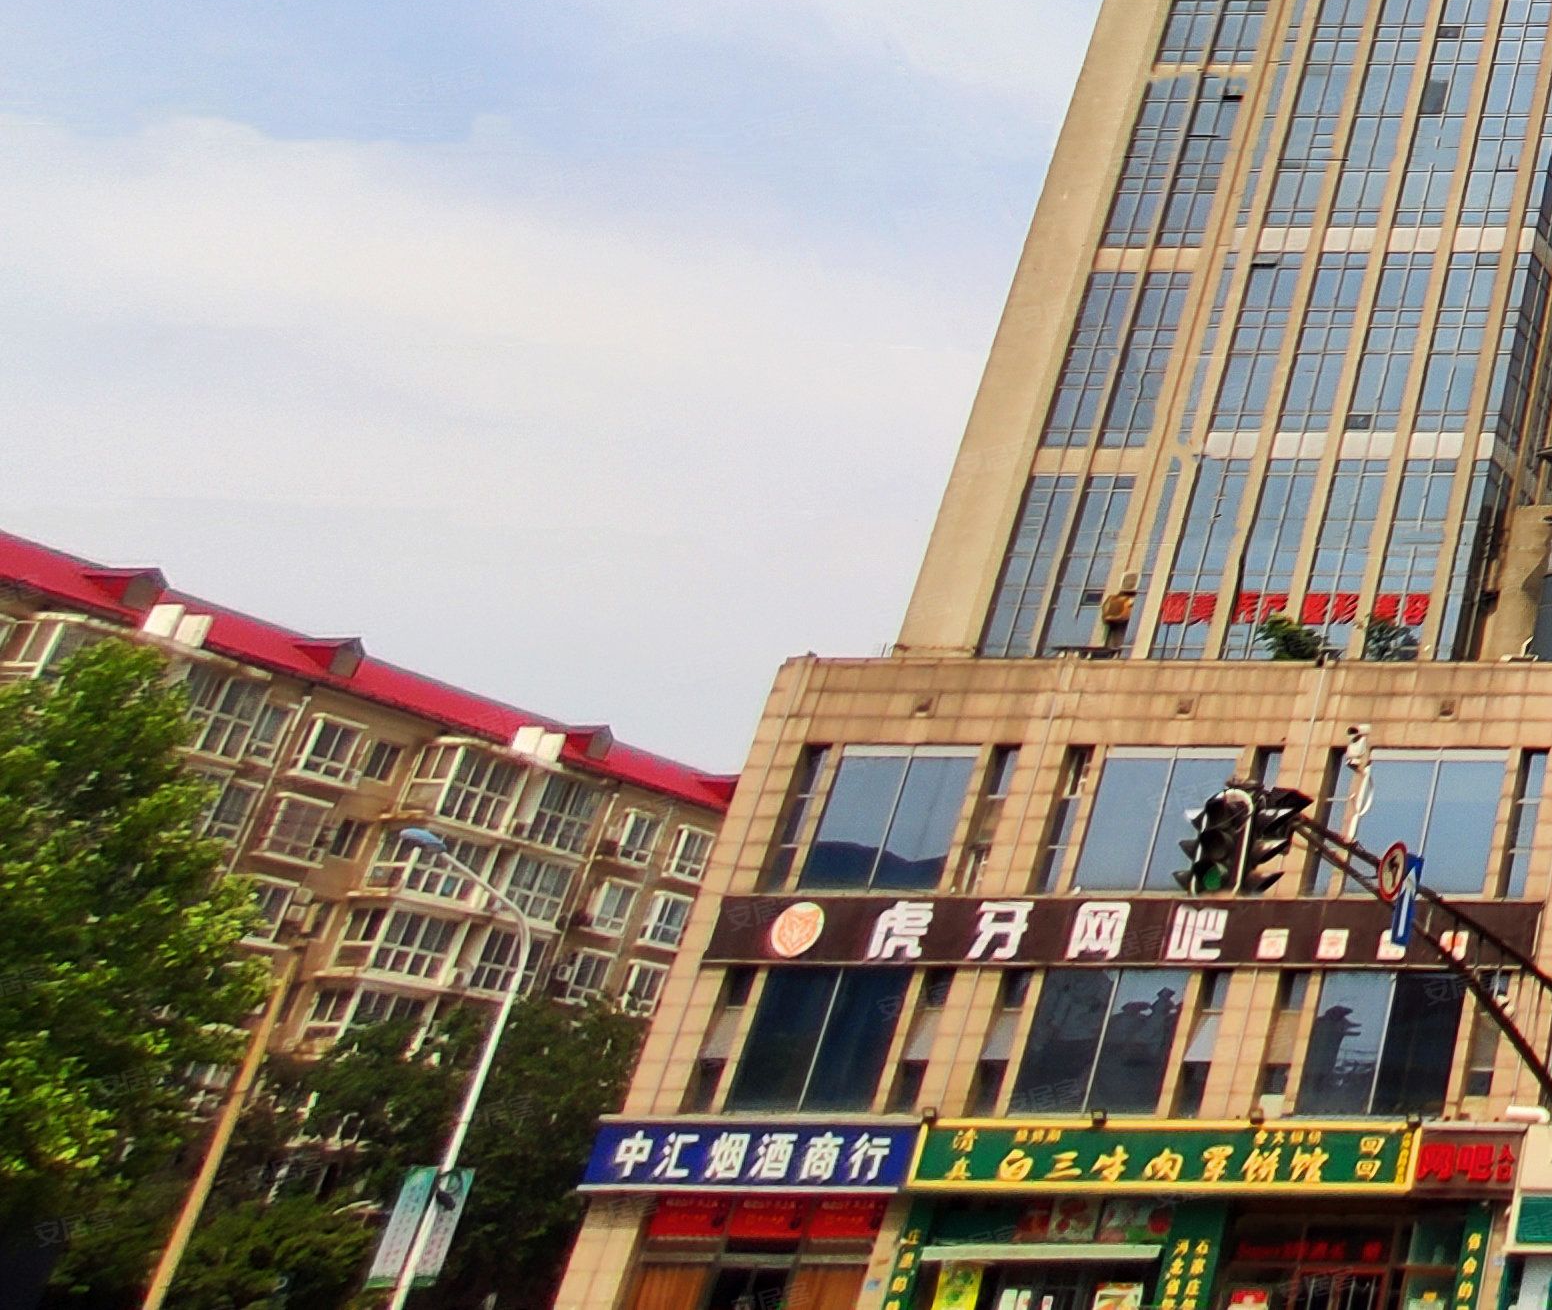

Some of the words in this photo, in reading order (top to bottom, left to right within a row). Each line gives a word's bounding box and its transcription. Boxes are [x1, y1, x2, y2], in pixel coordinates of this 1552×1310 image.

[866, 901, 1228, 961] 虎牙网吧
[613, 1129, 892, 1180] 中汇烟酒商行
[1416, 1143, 1496, 1182] 网吧
